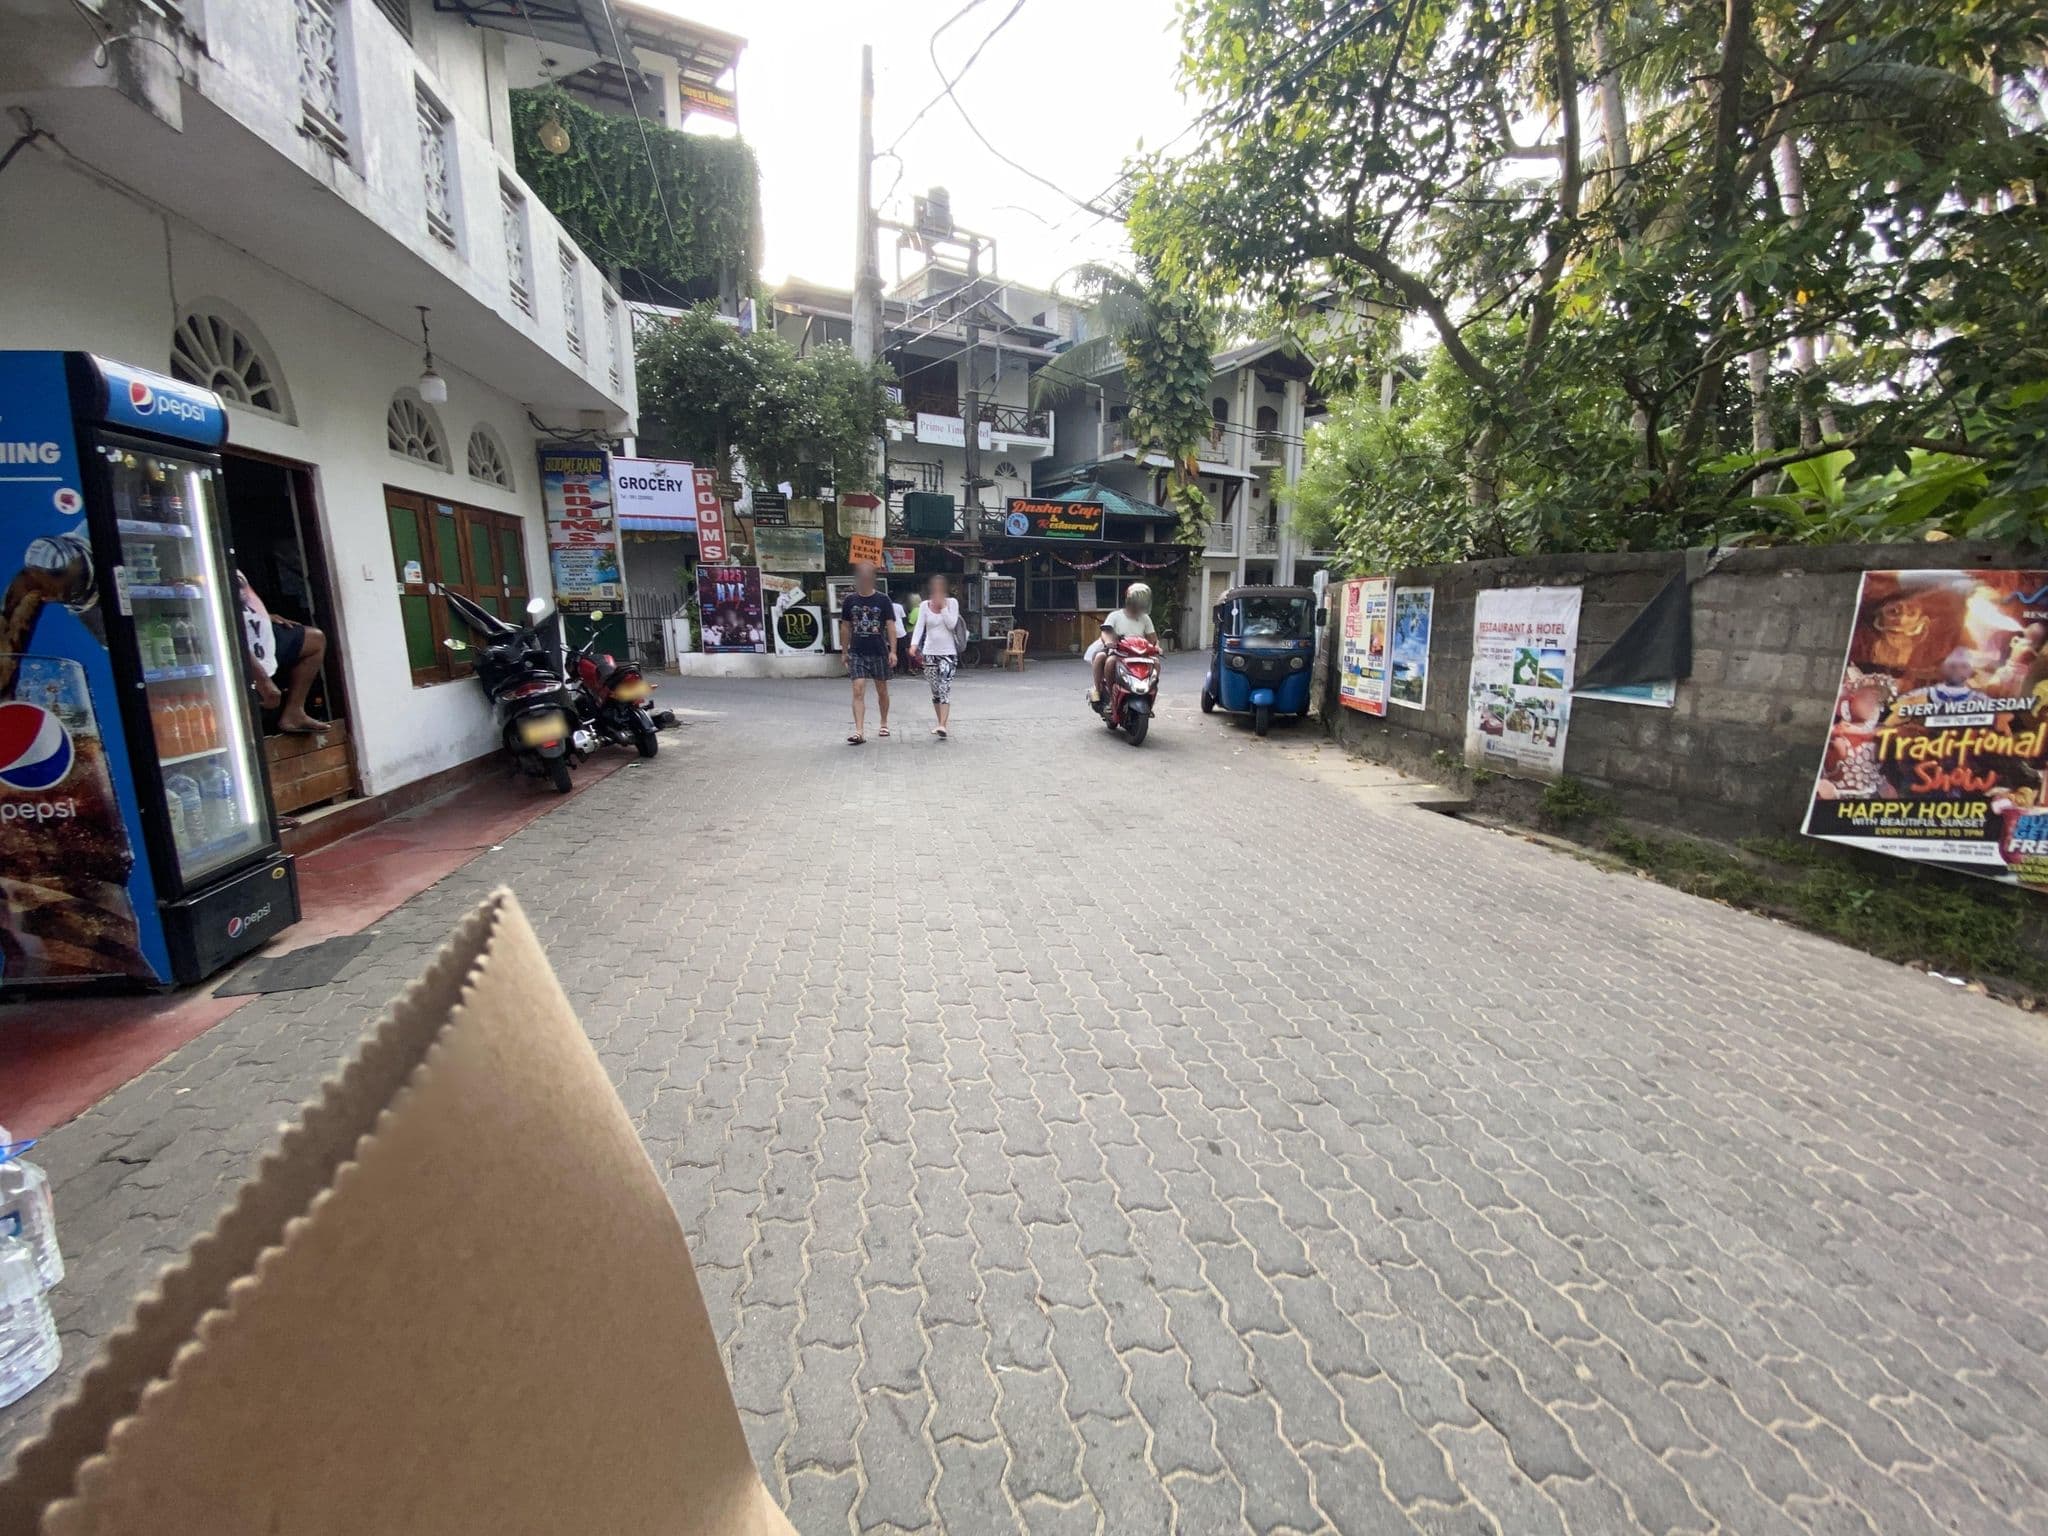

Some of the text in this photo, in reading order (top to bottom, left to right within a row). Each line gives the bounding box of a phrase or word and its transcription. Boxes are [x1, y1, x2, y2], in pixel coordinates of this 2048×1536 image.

[158, 396, 206, 422] pepsi
[920, 420, 944, 433] Prime
[947, 422, 963, 435] Tim
[0, 442, 61, 464] ING
[544, 457, 602, 473] BOOMERANG
[618, 476, 683, 492] GROCERY
[561, 483, 601, 541] ROOMS
[695, 473, 722, 559] ROOMS
[1067, 503, 1101, 518] Cafe
[718, 569, 742, 582] 2025
[716, 583, 745, 602] NYE
[1479, 622, 1567, 635] RESTAURANT & HOTEL
[1899, 696, 2037, 716] EVERY WEDNESDAY
[1876, 722, 2048, 766] Traditional
[1910, 760, 1998, 793] Show
[0, 797, 76, 824] pepsi
[1837, 802, 1987, 820] HAPPY HOUR
[1874, 827, 1904, 836] EVERY
[1879, 818, 1937, 827] BEAUTIFUL
[1940, 819, 1986, 828] SUNSET
[243, 902, 271, 929] pepsi
